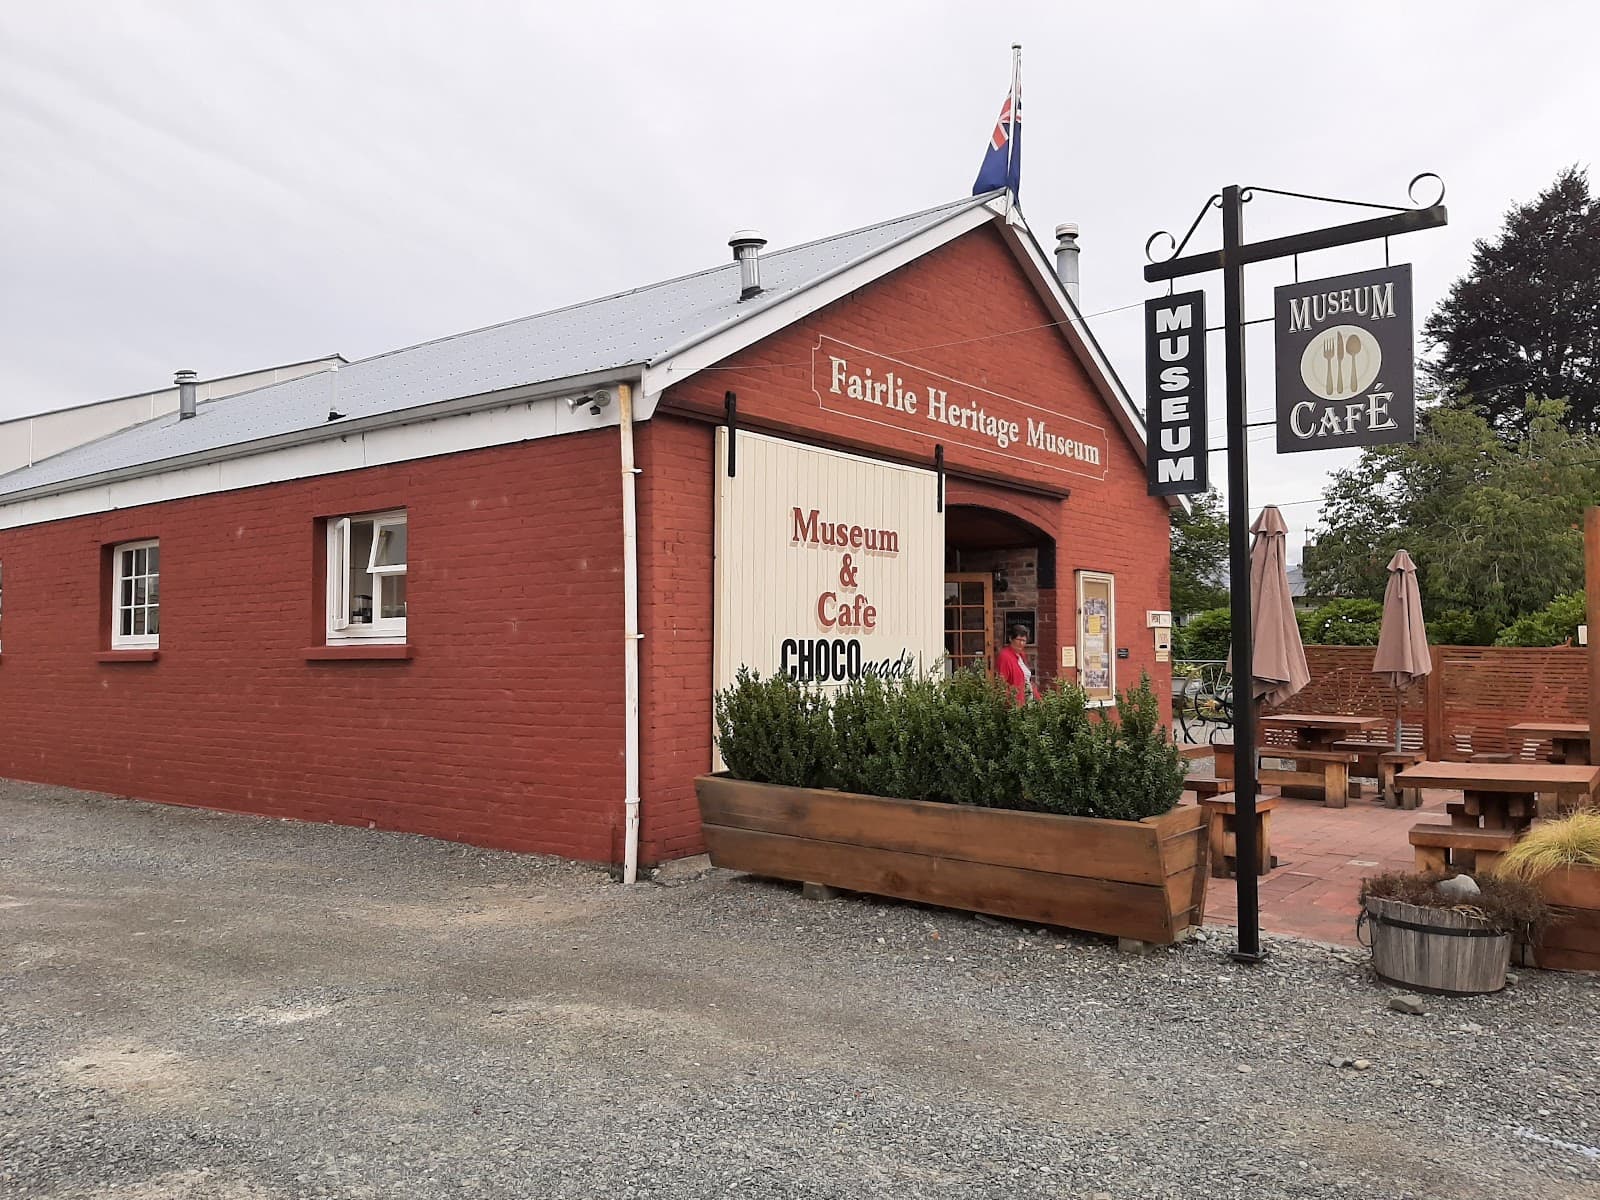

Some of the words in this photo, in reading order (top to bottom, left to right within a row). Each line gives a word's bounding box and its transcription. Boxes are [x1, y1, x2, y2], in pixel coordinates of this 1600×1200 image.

[1289, 282, 1396, 333] MUSEUM
[829, 356, 917, 414] Fairlie
[927, 386, 1019, 448] Heritage
[1026, 417, 1100, 465] Museum
[1156, 304, 1194, 483] MUSEUM
[1290, 383, 1398, 439] CAFÉ
[792, 507, 899, 552] Museum
[839, 553, 858, 587] &
